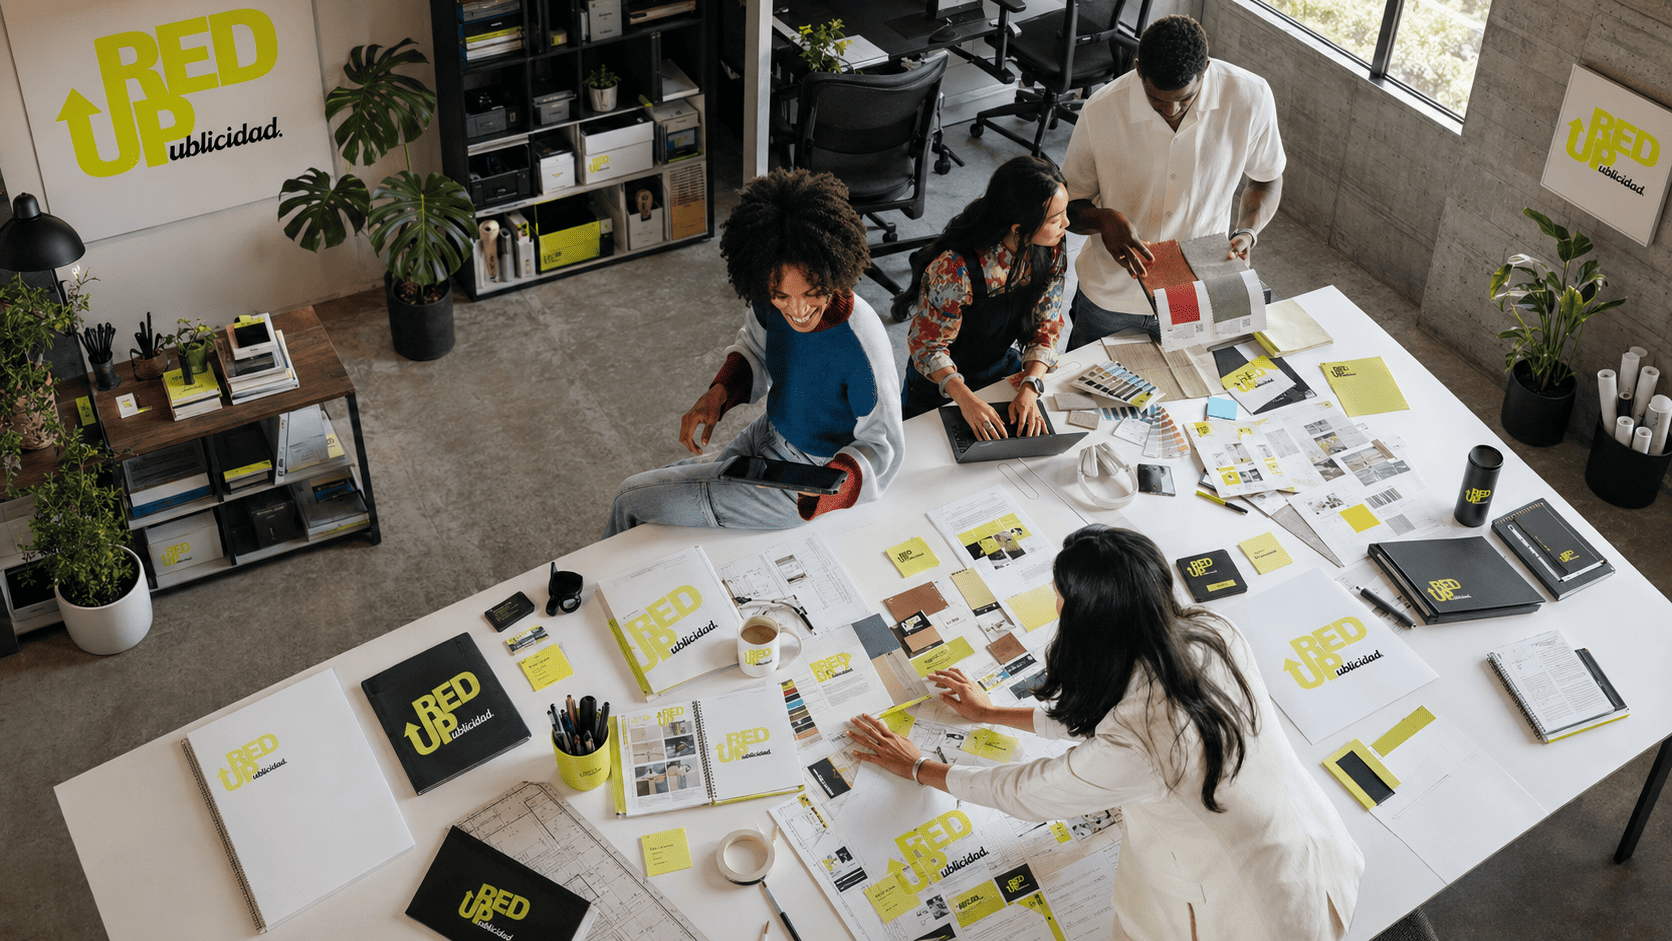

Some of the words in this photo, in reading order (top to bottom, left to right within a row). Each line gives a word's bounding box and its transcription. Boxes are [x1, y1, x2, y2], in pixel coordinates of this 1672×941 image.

[94, 8, 278, 100] RED
[1589, 107, 1660, 168] RED
[1189, 557, 1213, 570] RED
[1428, 578, 1462, 592] RED
[624, 585, 703, 640] RED
[1289, 616, 1367, 659] RED
[411, 671, 481, 721] RED
[225, 733, 279, 765] RED
[726, 726, 770, 748] RED
[894, 810, 973, 858] RED
[477, 883, 531, 920] RED
